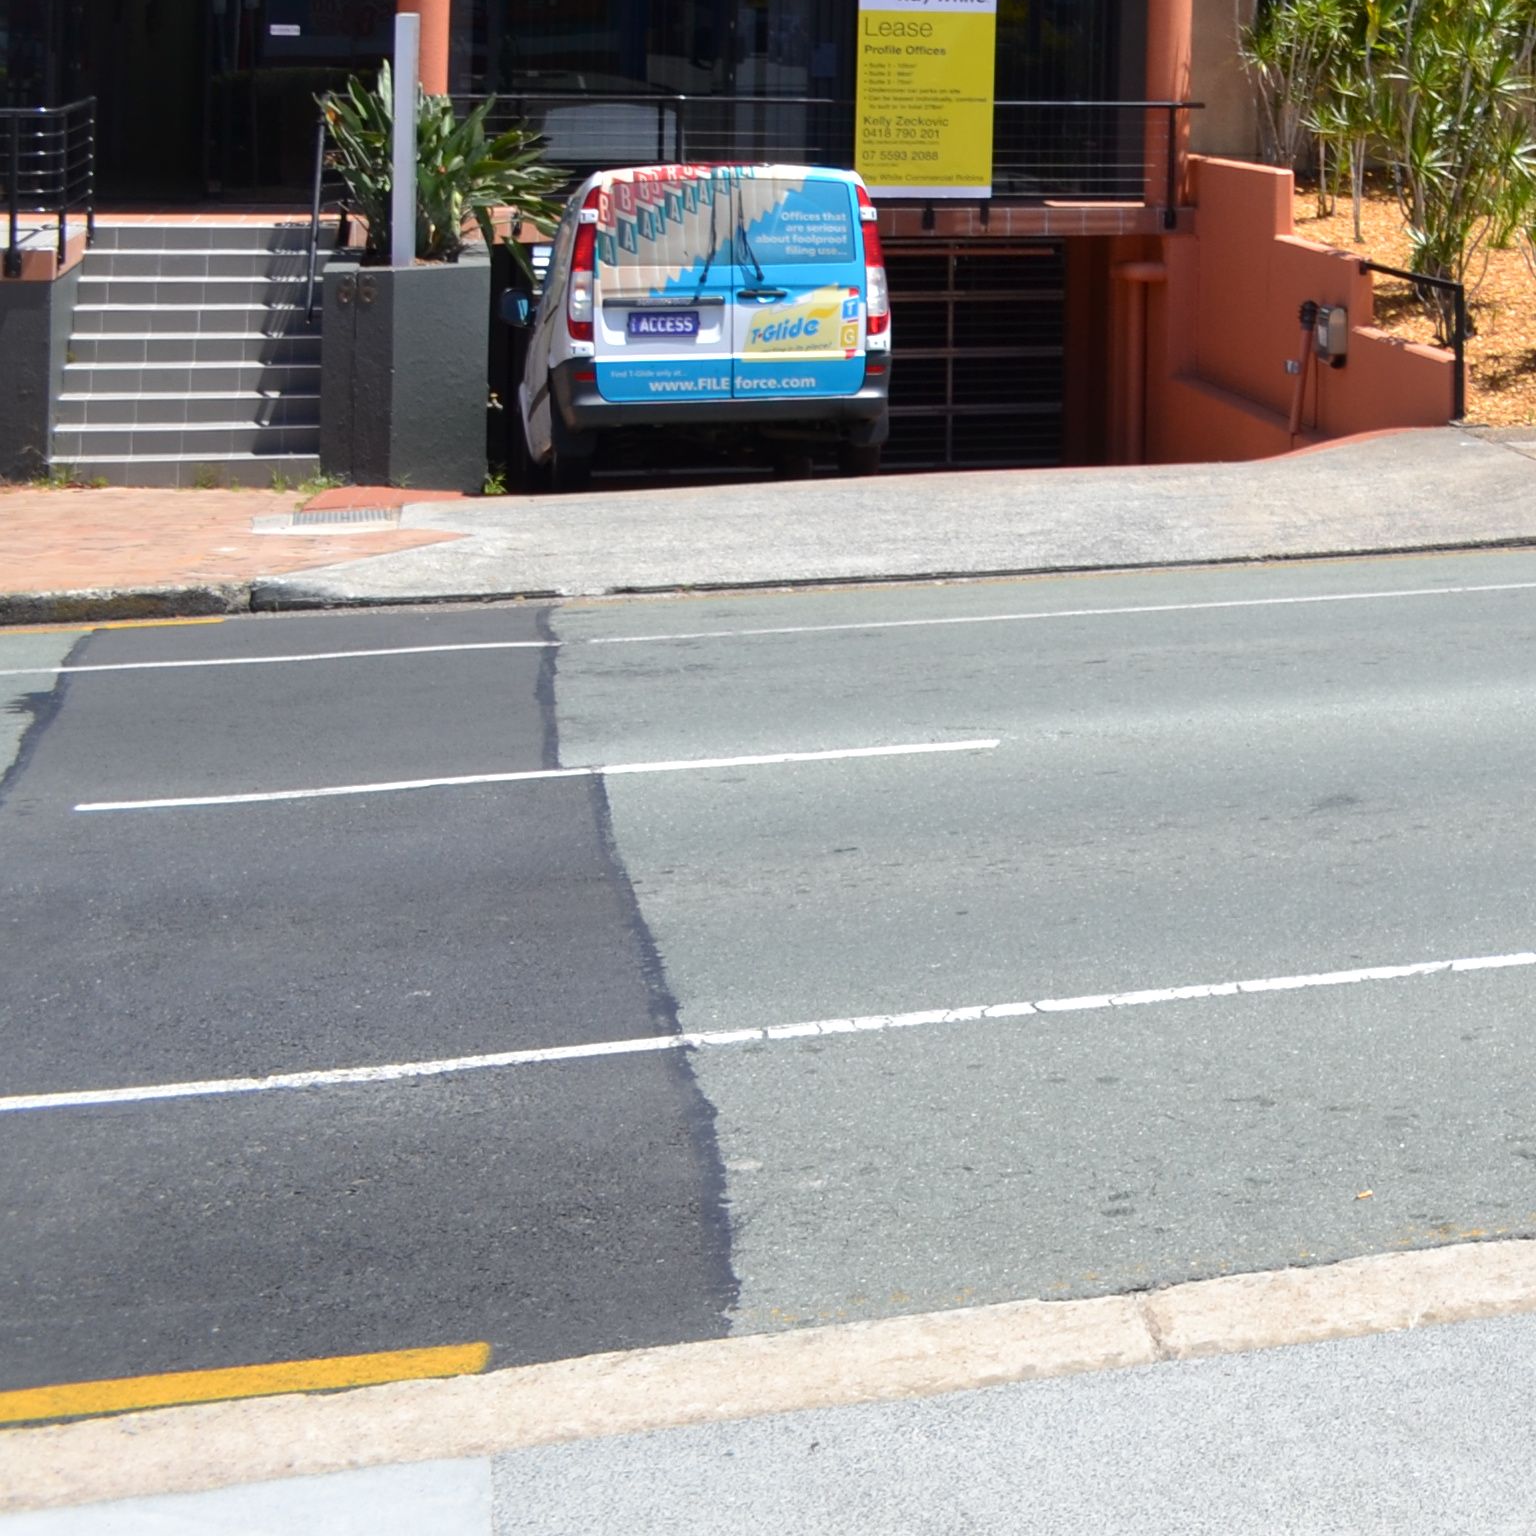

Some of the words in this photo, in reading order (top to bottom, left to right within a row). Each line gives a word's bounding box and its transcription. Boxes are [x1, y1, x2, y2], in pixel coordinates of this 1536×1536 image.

[864, 17, 933, 38] Lease
[864, 45, 902, 56] Profile
[905, 45, 946, 56] Offices
[864, 116, 891, 127] Kelly
[862, 150, 876, 160] 07
[781, 211, 820, 222] Offices
[822, 212, 847, 222] that
[785, 224, 804, 233] are
[806, 223, 847, 233] serious
[755, 234, 790, 244] about
[792, 234, 848, 246] foolproof
[639, 316, 693, 333] ACCESS
[751, 317, 820, 345] T-Glide
